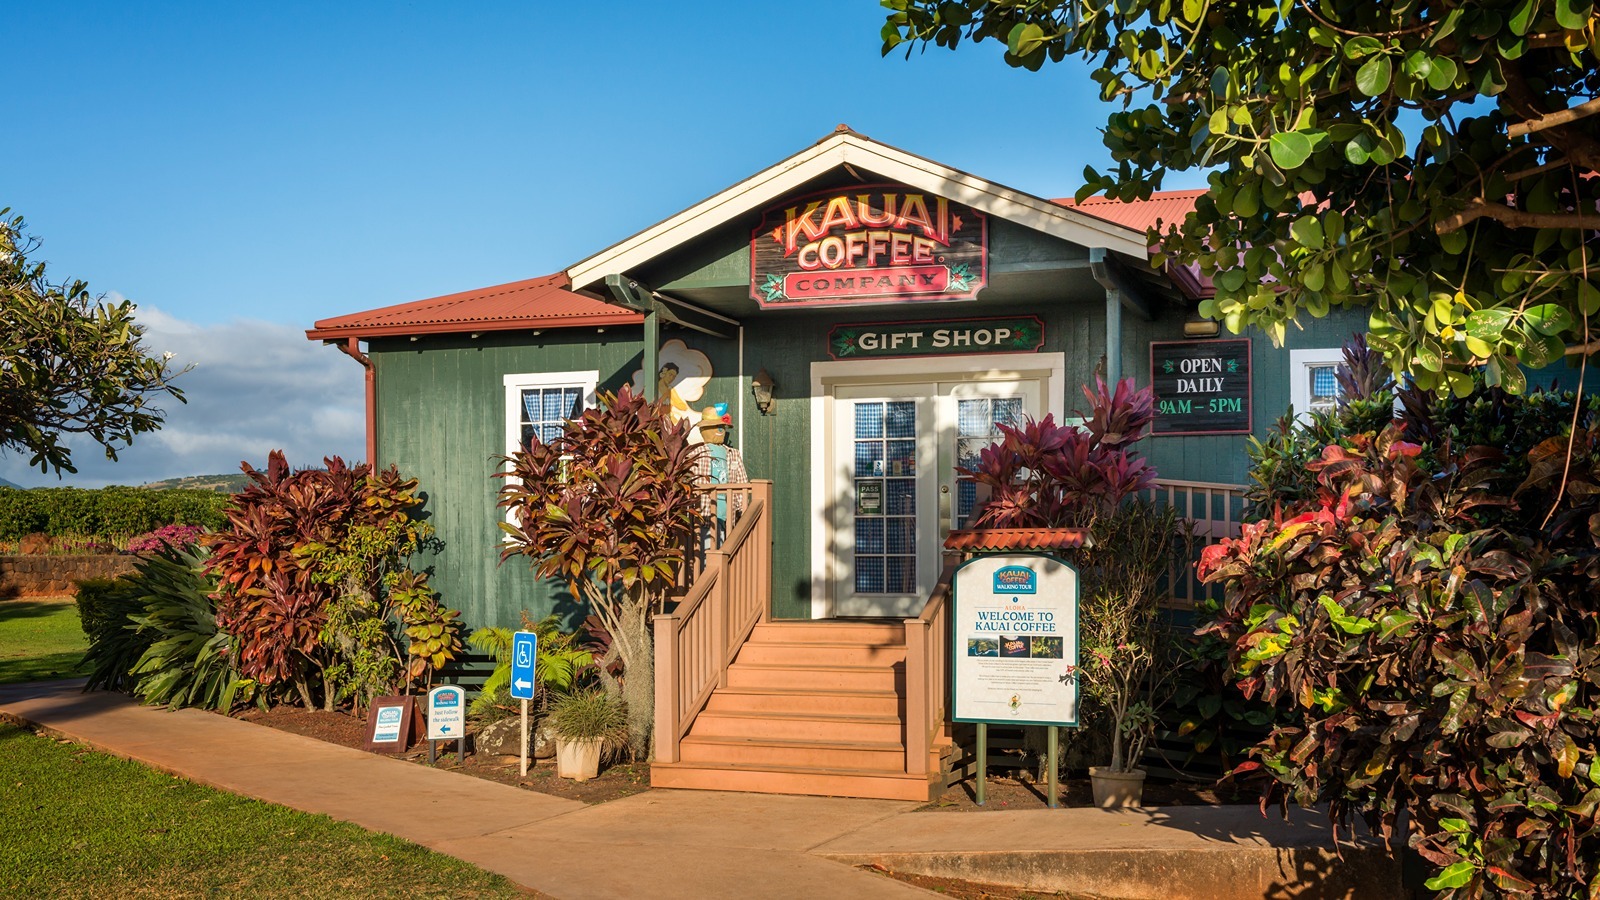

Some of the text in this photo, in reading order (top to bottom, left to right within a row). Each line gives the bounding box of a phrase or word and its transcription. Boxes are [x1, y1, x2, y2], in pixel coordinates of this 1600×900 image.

[784, 193, 950, 258] KAUAI
[797, 230, 937, 270] COFFEE
[795, 273, 938, 291] COMPANY
[858, 328, 1011, 350] GIFT SHOP
[1180, 358, 1222, 374] OPEN
[1176, 377, 1224, 393] DAILY
[1160, 400, 1191, 414] 9AM
[1209, 398, 1242, 413] 5PM
[999, 570, 1029, 580] KAUAI
[978, 611, 1054, 621] WELCOME TO
[975, 621, 1056, 632] KAUAI COFFEE
